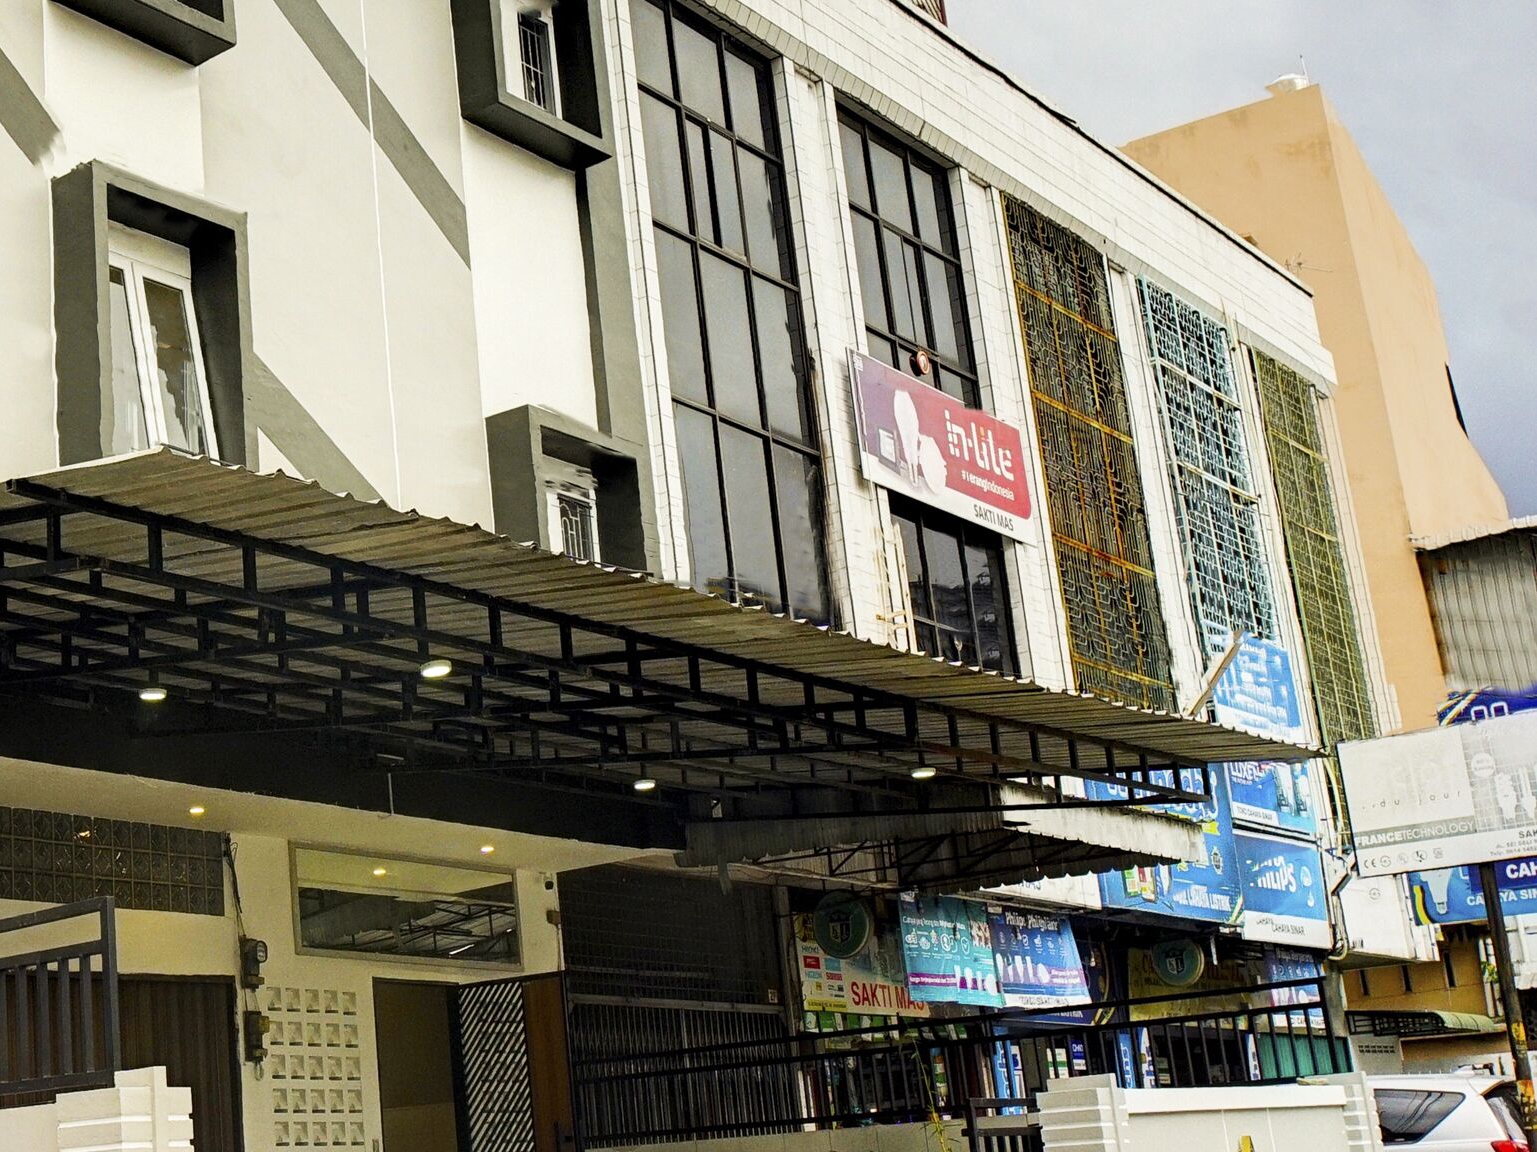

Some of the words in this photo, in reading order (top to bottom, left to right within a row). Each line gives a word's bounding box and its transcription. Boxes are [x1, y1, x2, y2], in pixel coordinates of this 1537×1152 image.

[973, 504, 996, 523] SAKTI
[996, 512, 1014, 531] MAS
[850, 980, 893, 1009] SAKTI
